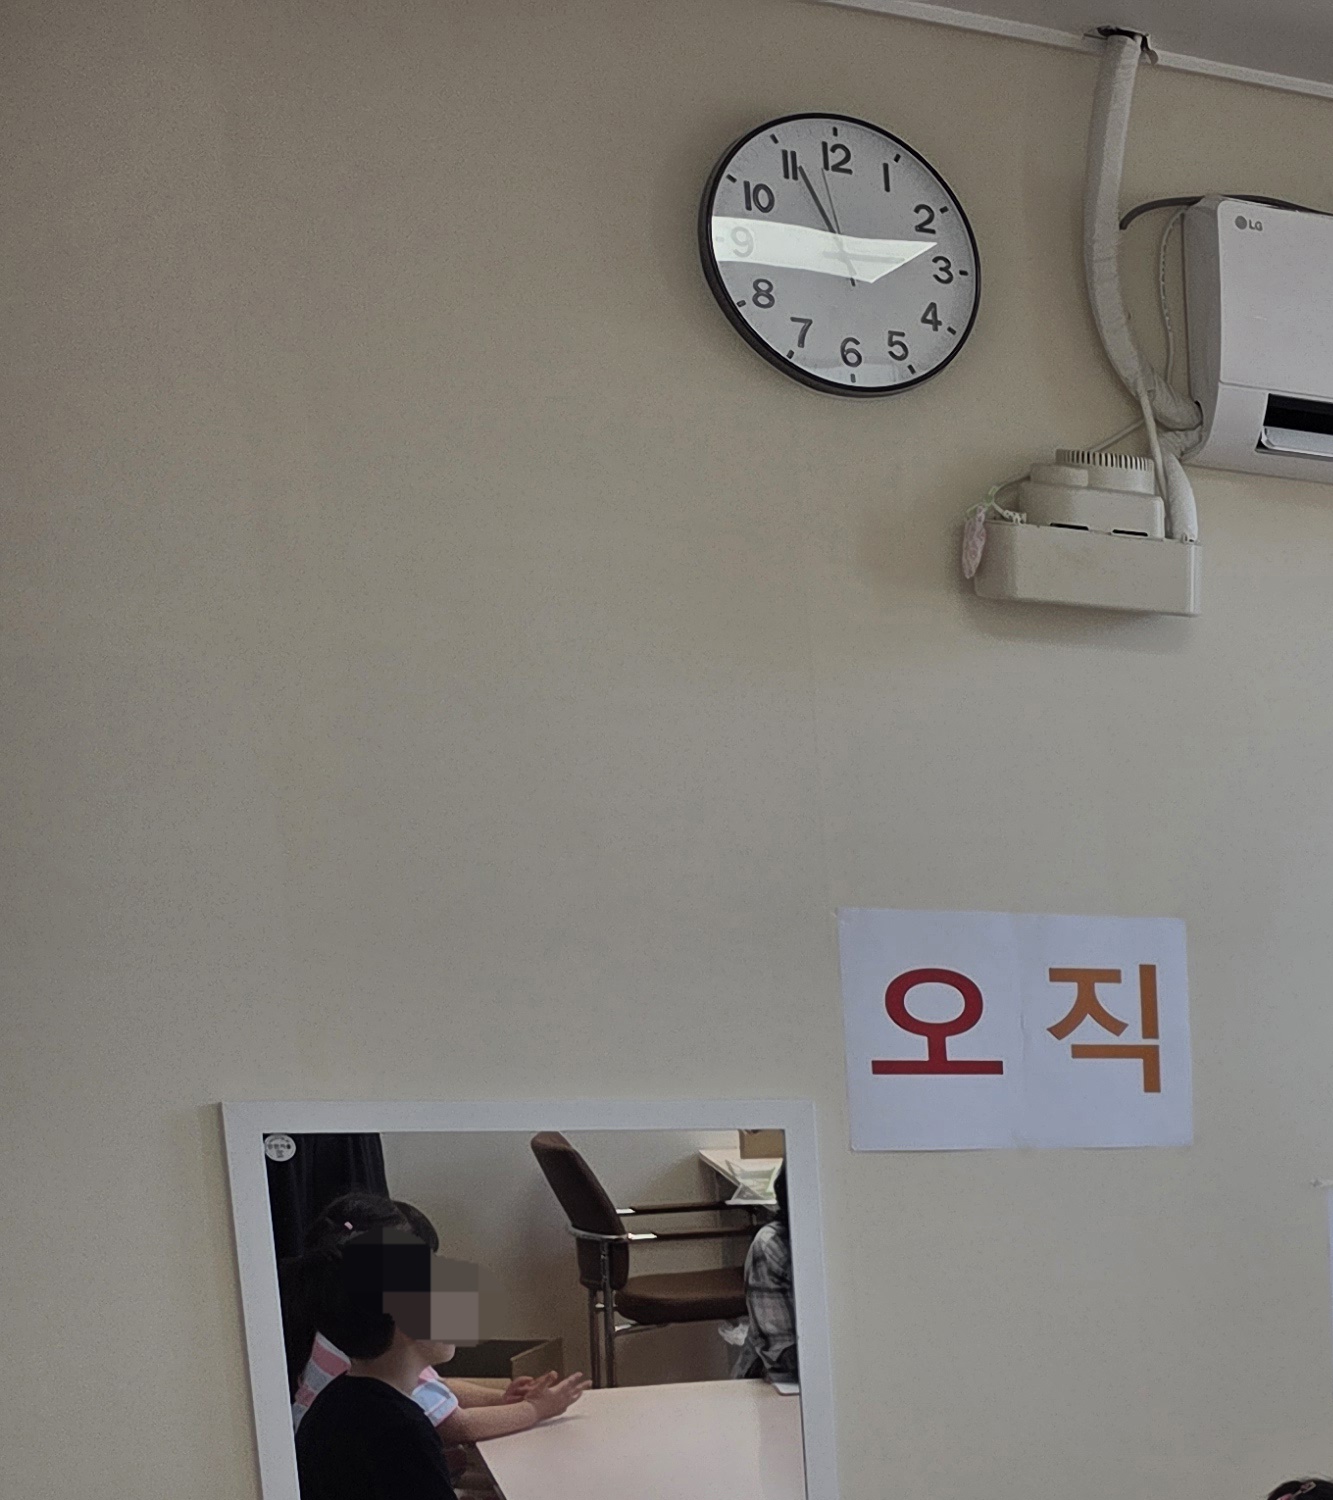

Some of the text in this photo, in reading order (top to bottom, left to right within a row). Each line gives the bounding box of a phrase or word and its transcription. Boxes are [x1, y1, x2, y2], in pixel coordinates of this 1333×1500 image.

[781, 149, 799, 181] 11
[821, 141, 853, 175] 12
[882, 162, 891, 193] 1
[743, 180, 775, 214] 10
[913, 203, 937, 235] 2
[1248, 219, 1263, 231] LG
[730, 226, 754, 258] 9
[931, 255, 954, 285] 3
[751, 278, 776, 309] 8
[790, 316, 813, 349] 7
[920, 302, 943, 332] 4
[840, 337, 862, 368] 6
[887, 330, 909, 362] 5
[871, 963, 1162, 1093] 오직
